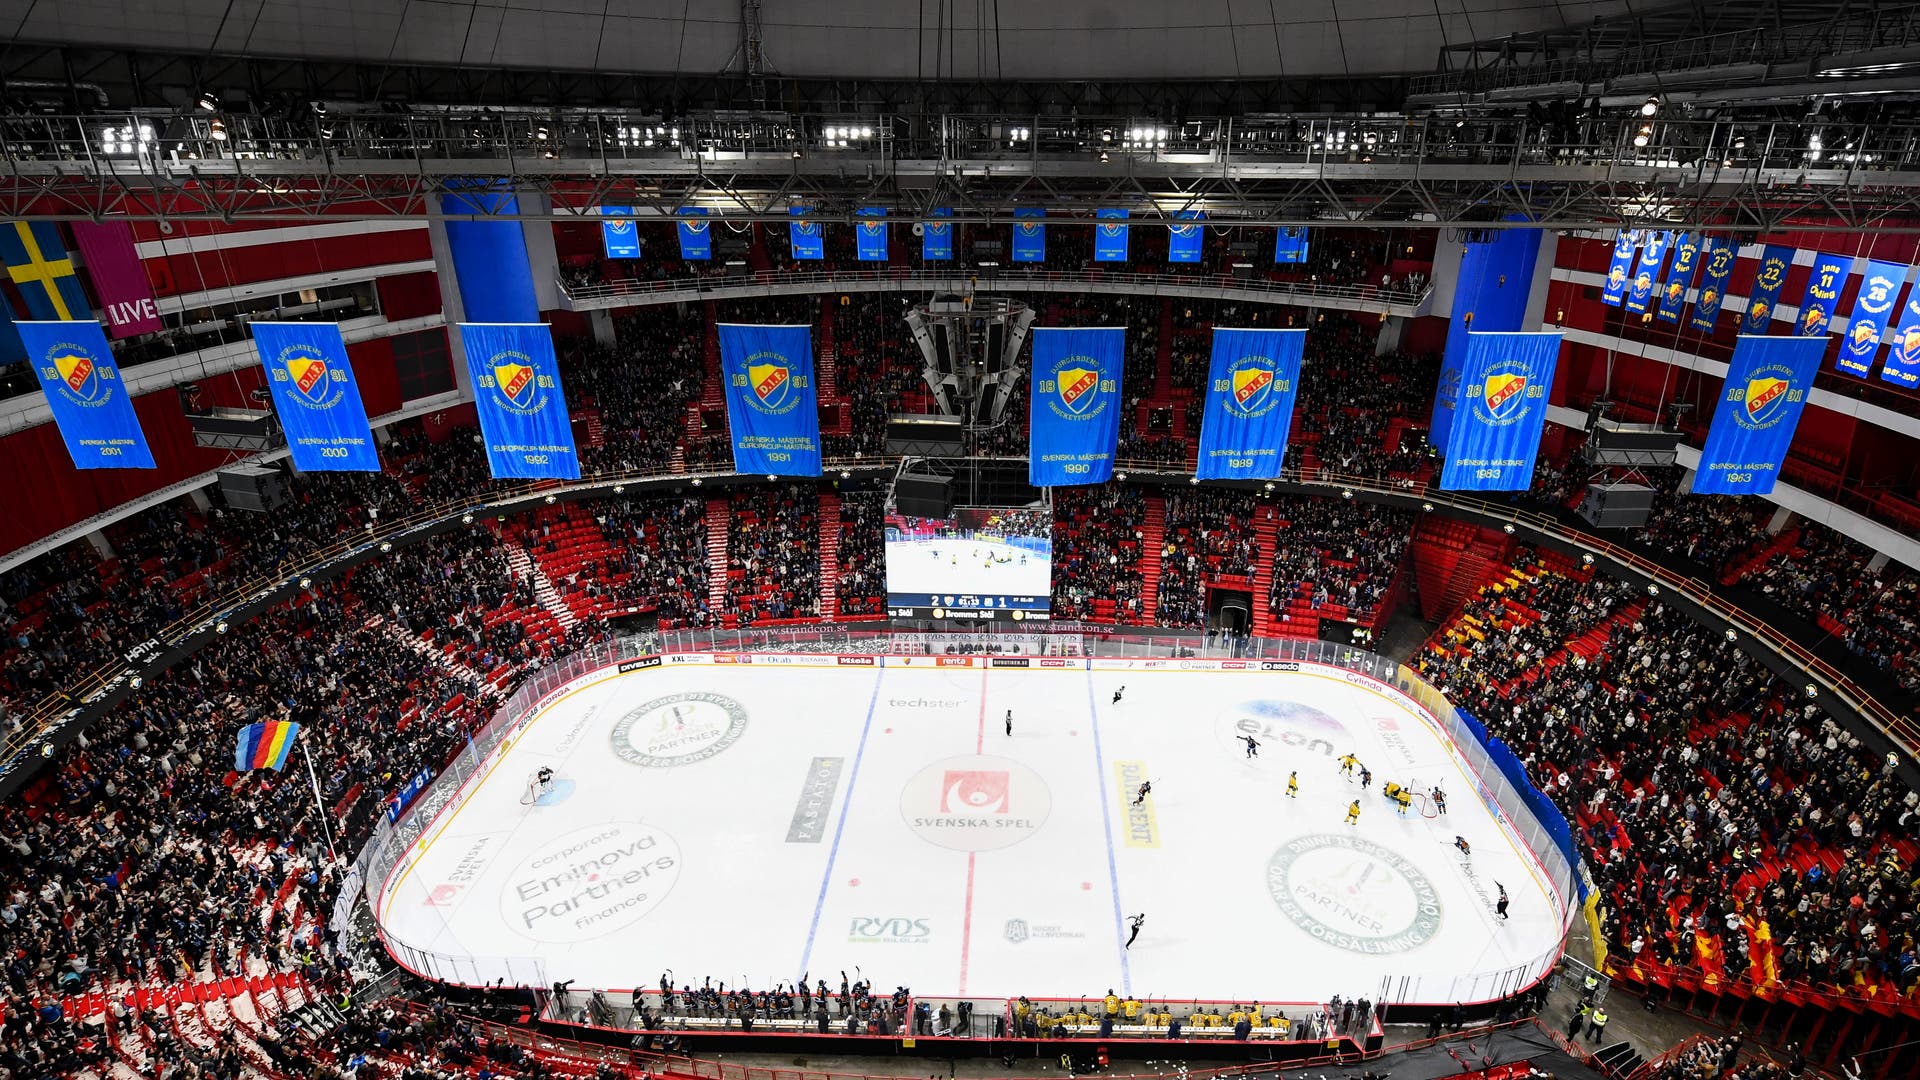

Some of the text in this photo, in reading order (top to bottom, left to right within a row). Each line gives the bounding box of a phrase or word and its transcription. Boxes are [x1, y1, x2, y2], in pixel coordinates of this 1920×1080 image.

[1681, 252, 1692, 262] 12
[1714, 256, 1728, 268] 27
[1764, 268, 1780, 280] 22
[1820, 264, 1840, 274] Jens
[1822, 275, 1834, 288] 11
[108, 298, 157, 326] LIVE
[478, 375, 554, 388] 18 91
[1040, 380, 1116, 393] 18 91
[1214, 380, 1290, 392] 18 91
[1466, 385, 1482, 397] 18
[1526, 386, 1544, 398] 91
[100, 448, 122, 456] 2001
[321, 448, 348, 458] 2000
[767, 452, 791, 462] 1991
[524, 455, 548, 464] 1992
[1229, 459, 1253, 468] 1989
[1064, 464, 1090, 474] 1990
[1476, 469, 1501, 478] 1983
[1727, 474, 1752, 482] 1963
[932, 596, 940, 606] 2
[999, 597, 1006, 607] 1
[946, 610, 978, 618] Bromma
[750, 624, 848, 637] www.strandcon.se
[1018, 622, 1114, 634] www.strandcon.se
[621, 658, 660, 672] DIVELLO
[943, 657, 966, 665] renta
[1346, 673, 1382, 692] Cylinda
[540, 687, 570, 708] BORGA
[648, 730, 720, 754] PARTNER
[914, 818, 1034, 828] SVENSKA SPEL
[532, 829, 620, 869] corporate
[448, 838, 489, 881] SVENSKA
[460, 859, 486, 882] SPEL
[516, 836, 656, 902] Eminova
[522, 856, 674, 929] Partners
[576, 893, 648, 928] finance
[1296, 885, 1383, 934] PARTNER
[849, 917, 930, 937] RYDS
